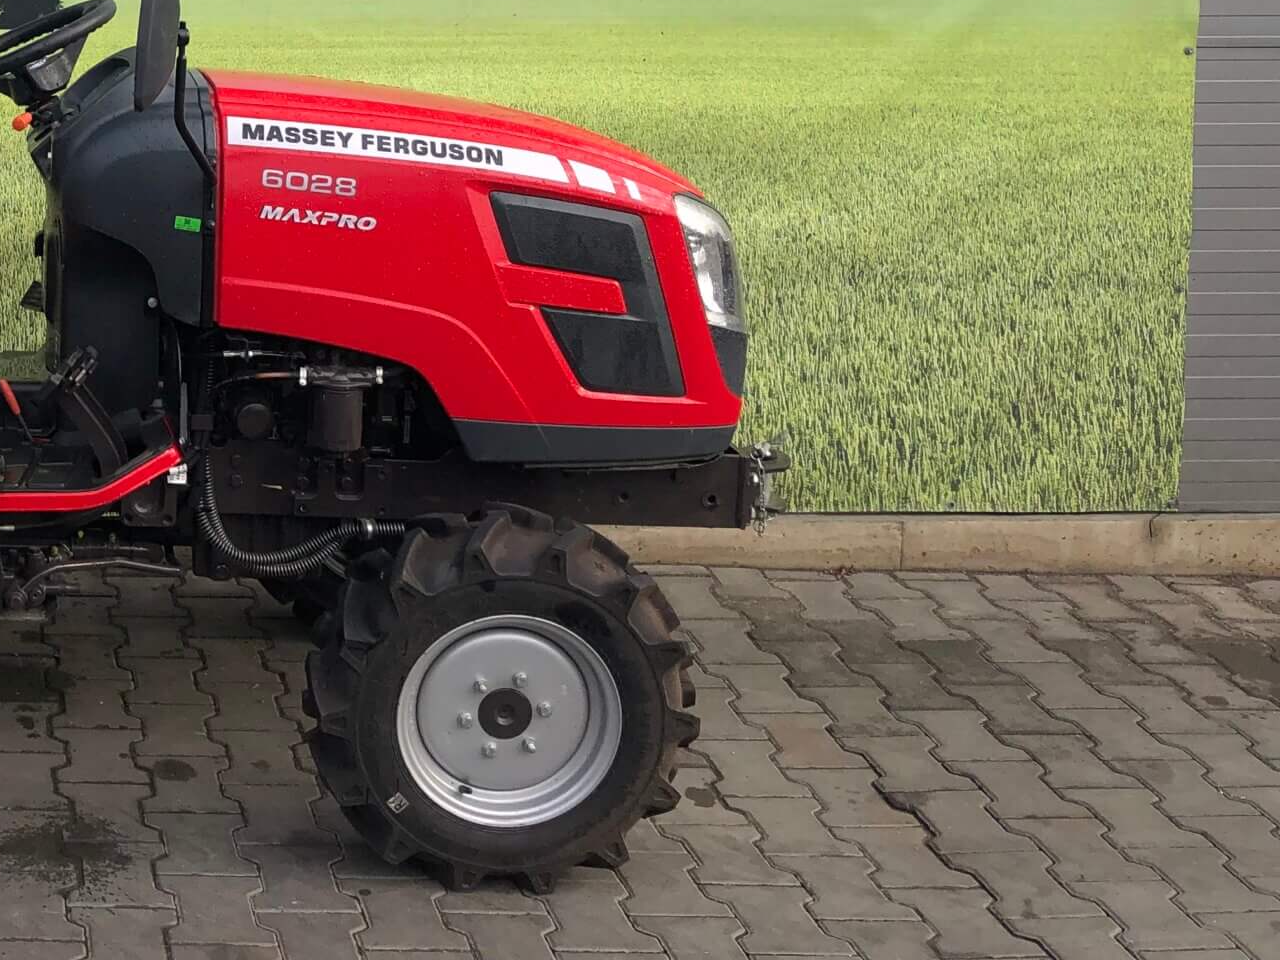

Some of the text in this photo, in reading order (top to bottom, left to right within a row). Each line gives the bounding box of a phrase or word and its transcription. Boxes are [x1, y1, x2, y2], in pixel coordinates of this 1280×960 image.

[241, 123, 504, 166] MASSEY FERGUSON
[261, 169, 357, 197] 6028
[260, 205, 377, 231] MAXPRO
